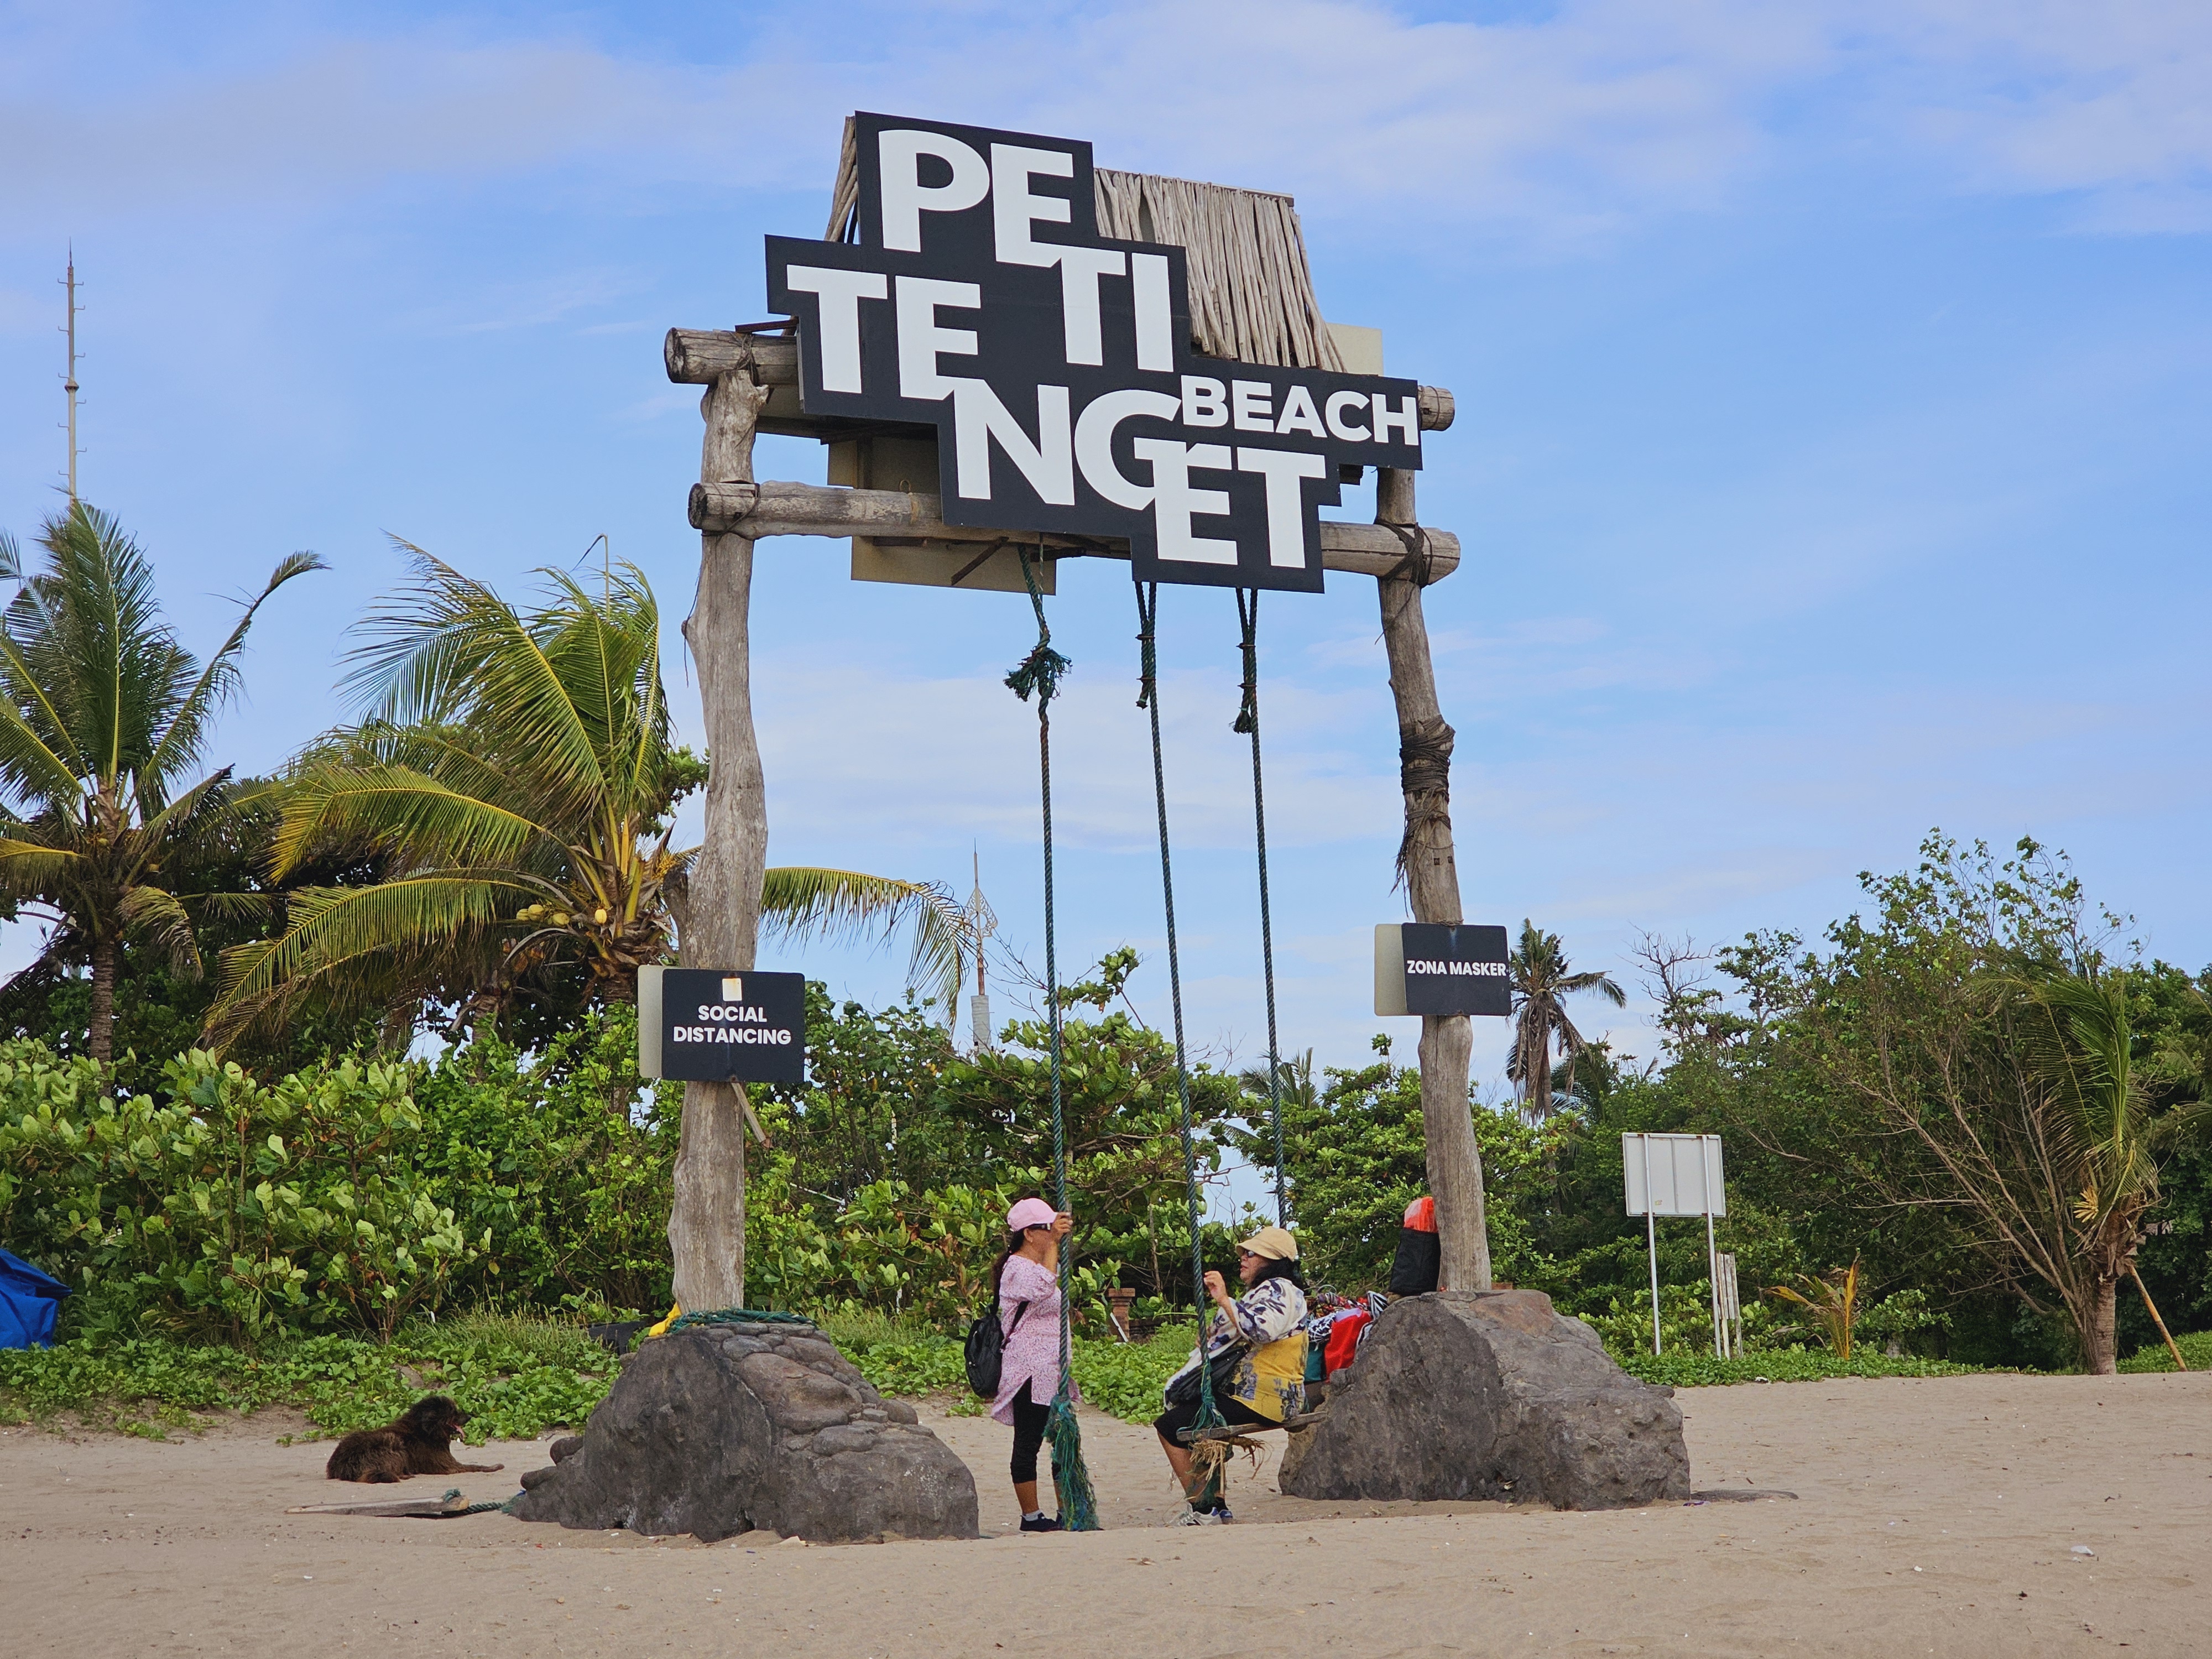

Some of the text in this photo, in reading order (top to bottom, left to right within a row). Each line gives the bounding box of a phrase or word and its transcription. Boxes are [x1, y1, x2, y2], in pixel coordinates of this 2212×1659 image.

[879, 130, 1073, 268] PE
[787, 265, 980, 400] TE
[1033, 242, 1173, 372] TI
[1181, 375, 1418, 446] BEACH
[1407, 960, 1506, 976] ZONA MASKER
[673, 1026, 791, 1045] DISTANCING
[698, 1005, 767, 1022] SOCIAL
